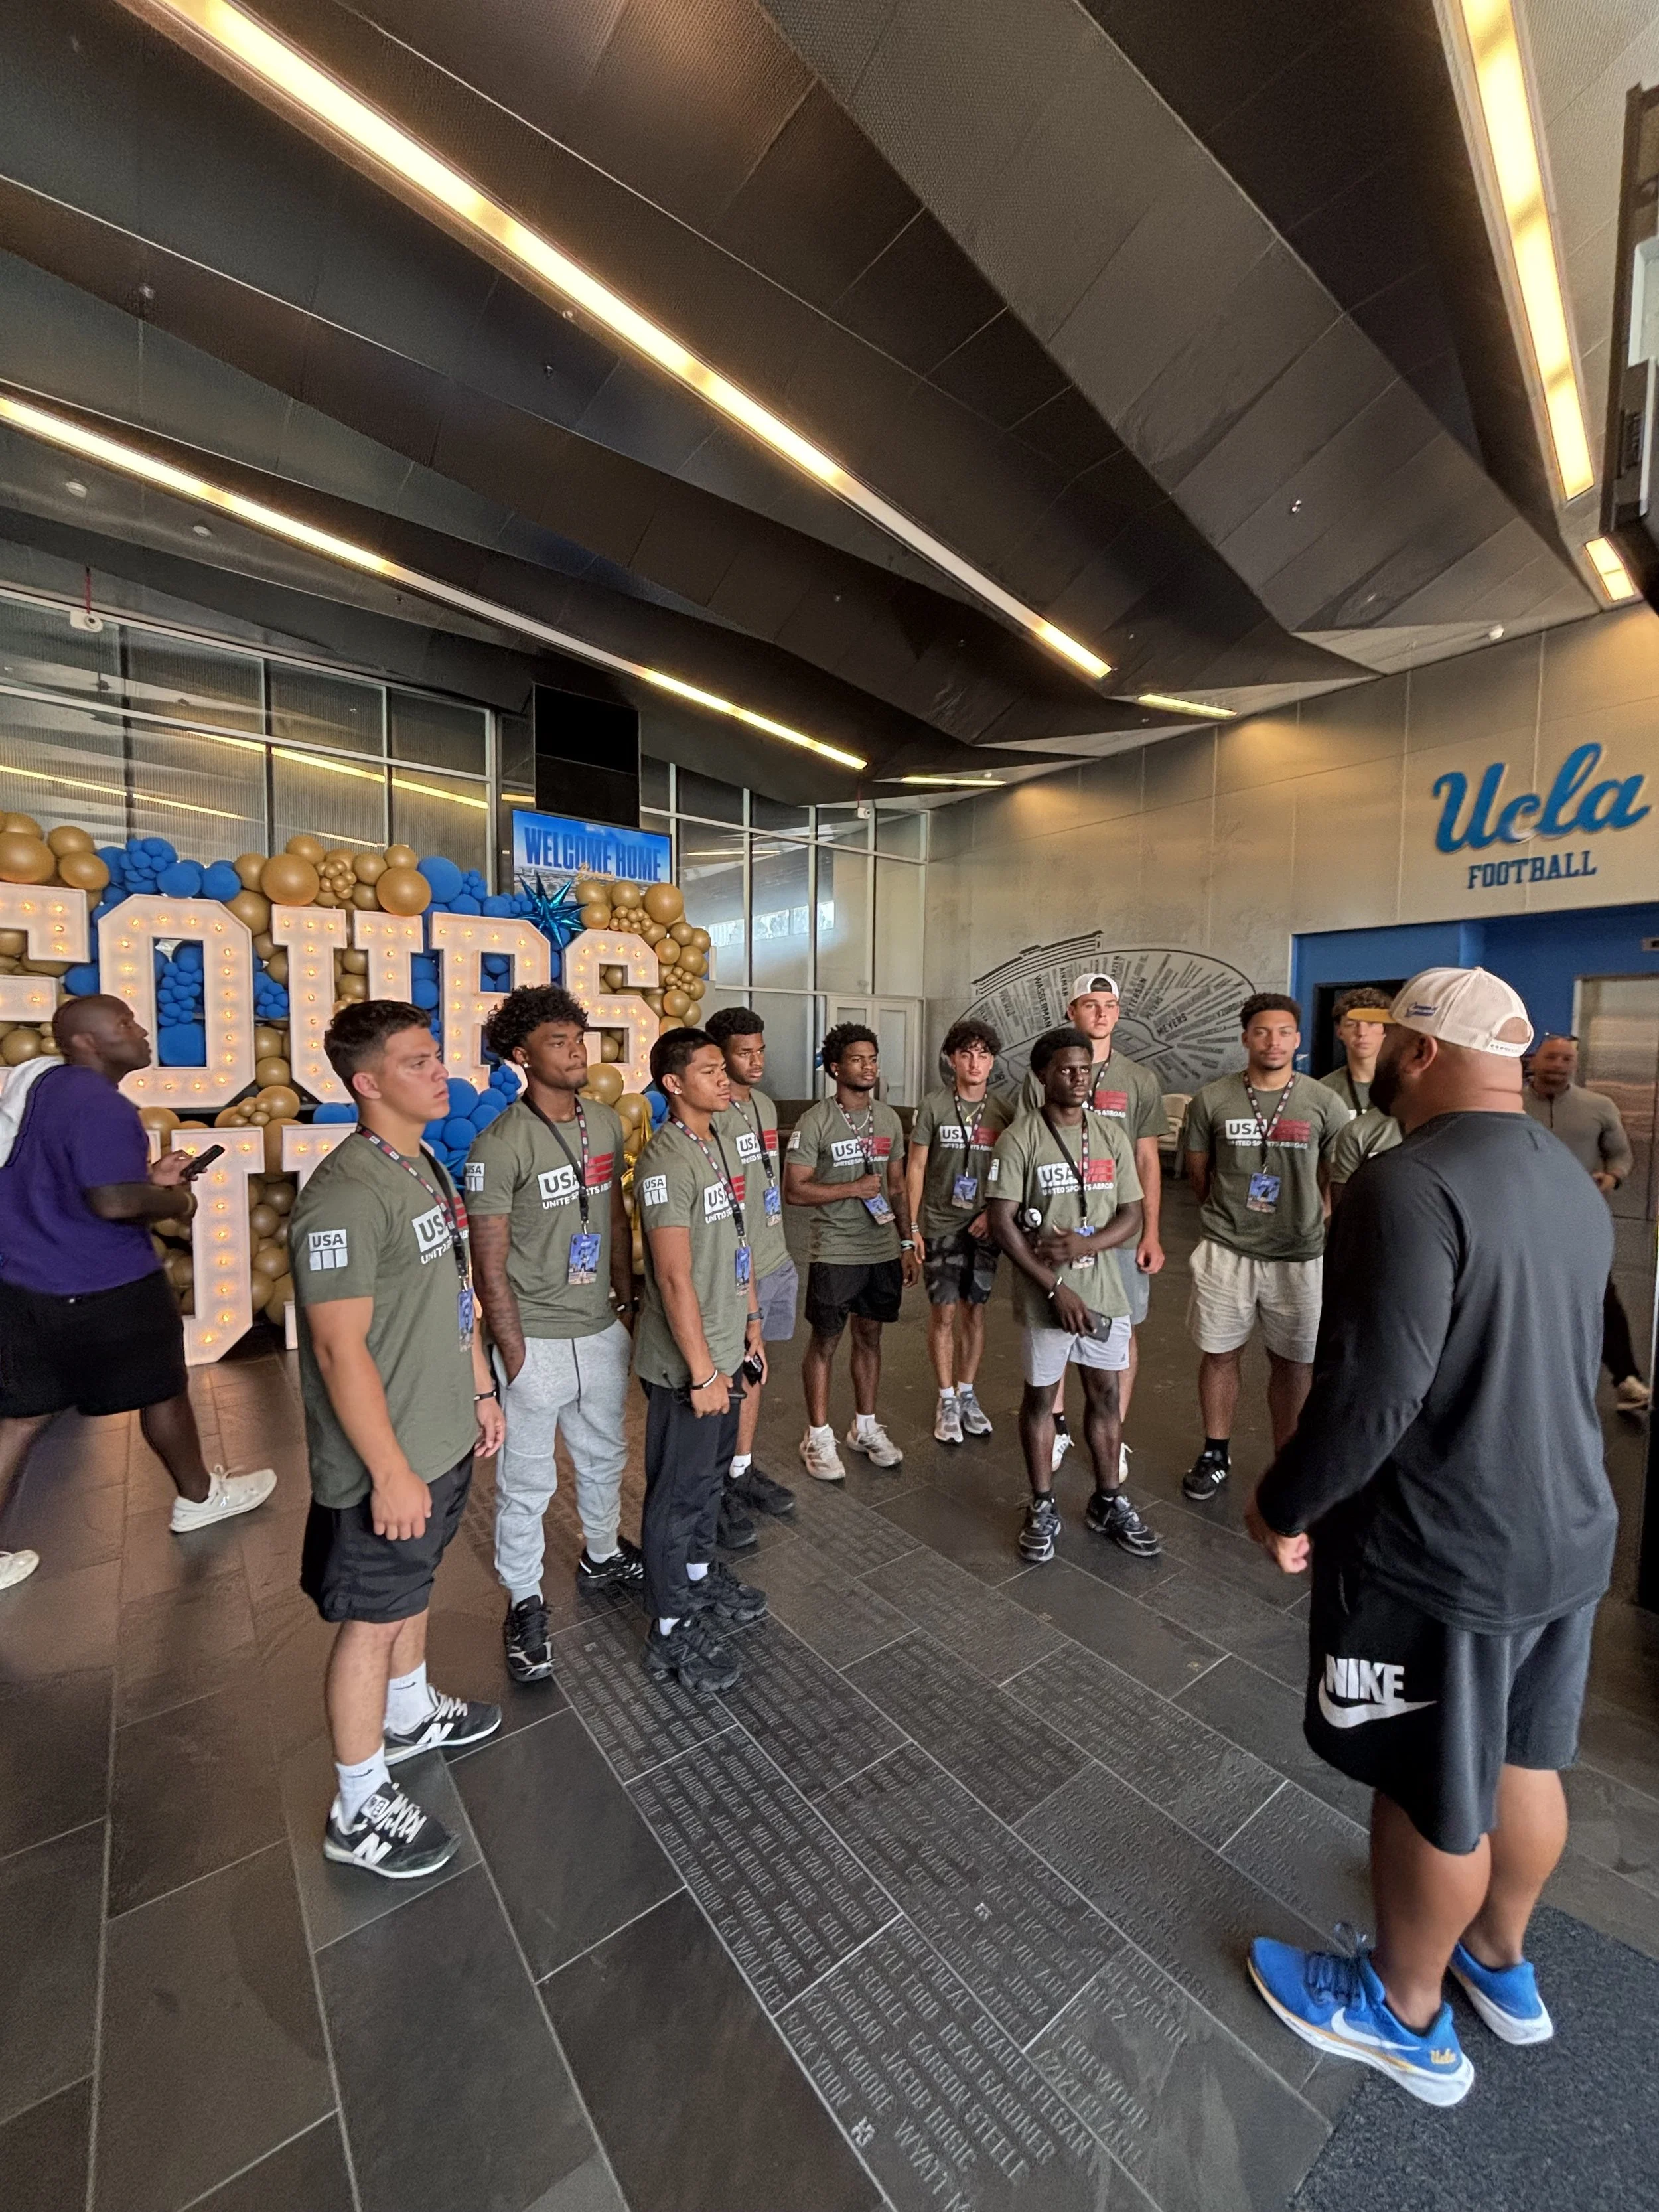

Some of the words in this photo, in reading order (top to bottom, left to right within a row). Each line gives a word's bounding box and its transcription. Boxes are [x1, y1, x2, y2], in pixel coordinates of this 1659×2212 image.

[524, 826, 612, 875] WELCOME
[615, 841, 662, 882] HOME
[1466, 849, 1597, 889] FOOTBALL
[1031, 973, 1053, 1029] WASSERMAN
[1058, 966, 1069, 997] AIKMAN
[1123, 977, 1147, 1017] PETERSON
[1156, 1013, 1189, 1037] MEYERS
[645, 1178, 664, 1190] USA
[1042, 1167, 1076, 1183] USA
[542, 1195, 571, 1210] UNITE
[312, 1233, 344, 1248] USA
[419, 1214, 449, 1244] US
[1325, 1653, 1406, 1704] NIKE
[653, 1818, 694, 1867] JOSEPH
[682, 1862, 727, 1917] VAUGHN
[913, 1840, 970, 1896] YANKOFF
[991, 1921, 1041, 1970] DEVIN
[660, 1679, 699, 1718] ANTHONY
[688, 1714, 729, 1753] ADKINS
[719, 1751, 759, 1792] JORDAN
[747, 1787, 803, 1847] ANDERSON
[794, 1844, 831, 1881] RYAN
[867, 1933, 906, 1977] KYLE
[898, 1972, 943, 2023] FORD
[936, 2020, 985, 2076] BEAU
[974, 2066, 1058, 2168] GARDNER
[715, 1913, 743, 1941] KJ
[792, 1743, 826, 1774] KAHO
[846, 1803, 909, 1866] KIRKWOOD
[952, 1917, 1006, 1972] LEWIS
[1059, 2032, 1153, 2136] NORWOOD
[603, 1702, 647, 1752] HENDERSON
[637, 1751, 678, 1797] JAYLAN
[665, 1792, 708, 1842] JEFFERS
[698, 1839, 722, 1862] TY
[710, 1857, 737, 1883] LEE
[729, 1884, 778, 1944] YUTAKA
[799, 1986, 853, 2053] KAYLIN
[841, 2045, 895, 2114] MOORE
[890, 2116, 951, 2198] WYATT
[650, 1732, 687, 1769] BRYAN
[672, 1763, 716, 1810] ADDISON
[707, 1809, 747, 1852] JALEN
[733, 1844, 780, 1898] BERGER
[772, 1897, 826, 1961] MATEEN
[877, 2040, 938, 2116] JACOB
[922, 2101, 982, 2177] BUSIC
[728, 1933, 788, 2012] WALLACE
[739, 1743, 780, 1785] MURPHY
[772, 1783, 813, 1823] ISAIAH
[801, 1816, 863, 1883] NEWCOMBE
[968, 2012, 1038, 2093] BRADEN
[1027, 2081, 1095, 2162] PEGAN
[746, 1822, 778, 1855] WILL
[768, 1850, 821, 1911] POWERS
[813, 1909, 869, 1973] COLLIN
[855, 1964, 912, 2030] SCHLEE
[904, 2028, 973, 2112] CARSON
[962, 2101, 1030, 2187] STEELE
[779, 2011, 819, 2059] SAM
[806, 2051, 853, 2112] YOON
